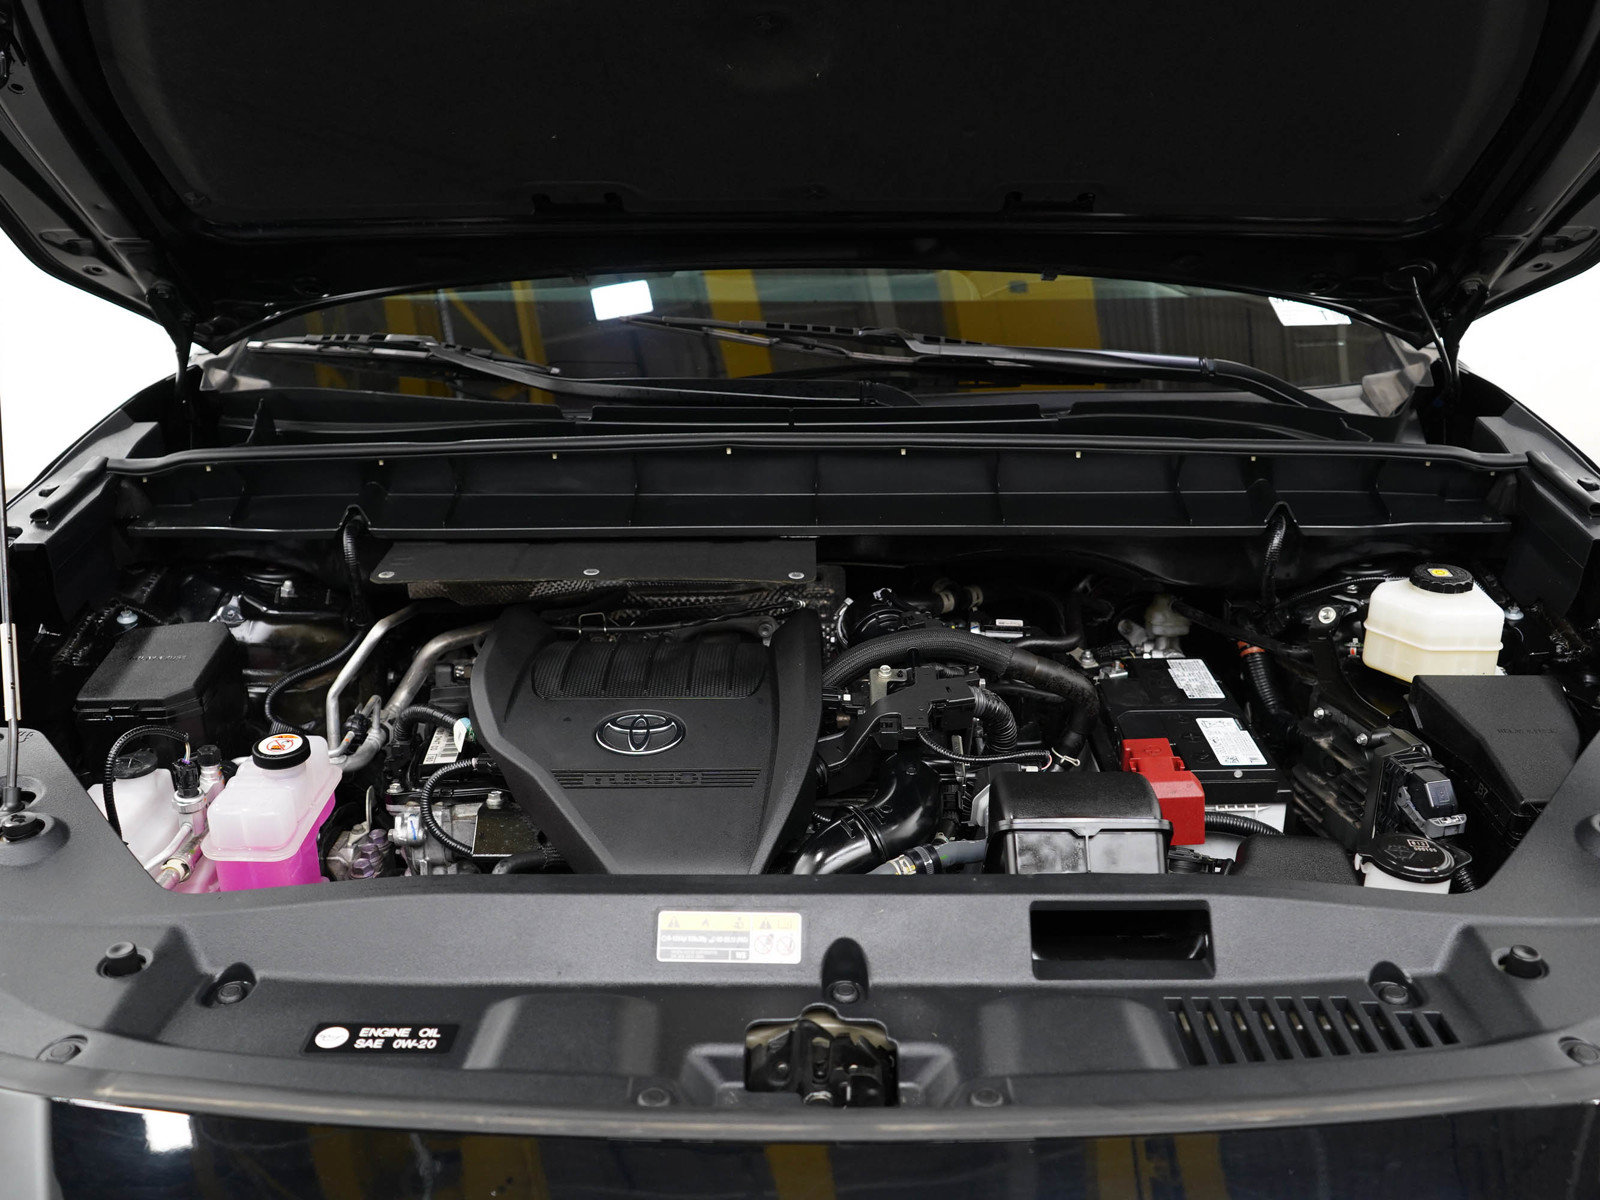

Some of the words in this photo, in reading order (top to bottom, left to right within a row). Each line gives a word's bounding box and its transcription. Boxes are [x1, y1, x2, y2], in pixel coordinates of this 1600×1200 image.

[585, 771, 700, 786] TURBO
[359, 1027, 412, 1037] ENGINE
[418, 1027, 441, 1038] OIL
[353, 1038, 385, 1049] SAE
[392, 1038, 437, 1049] 0W-20
